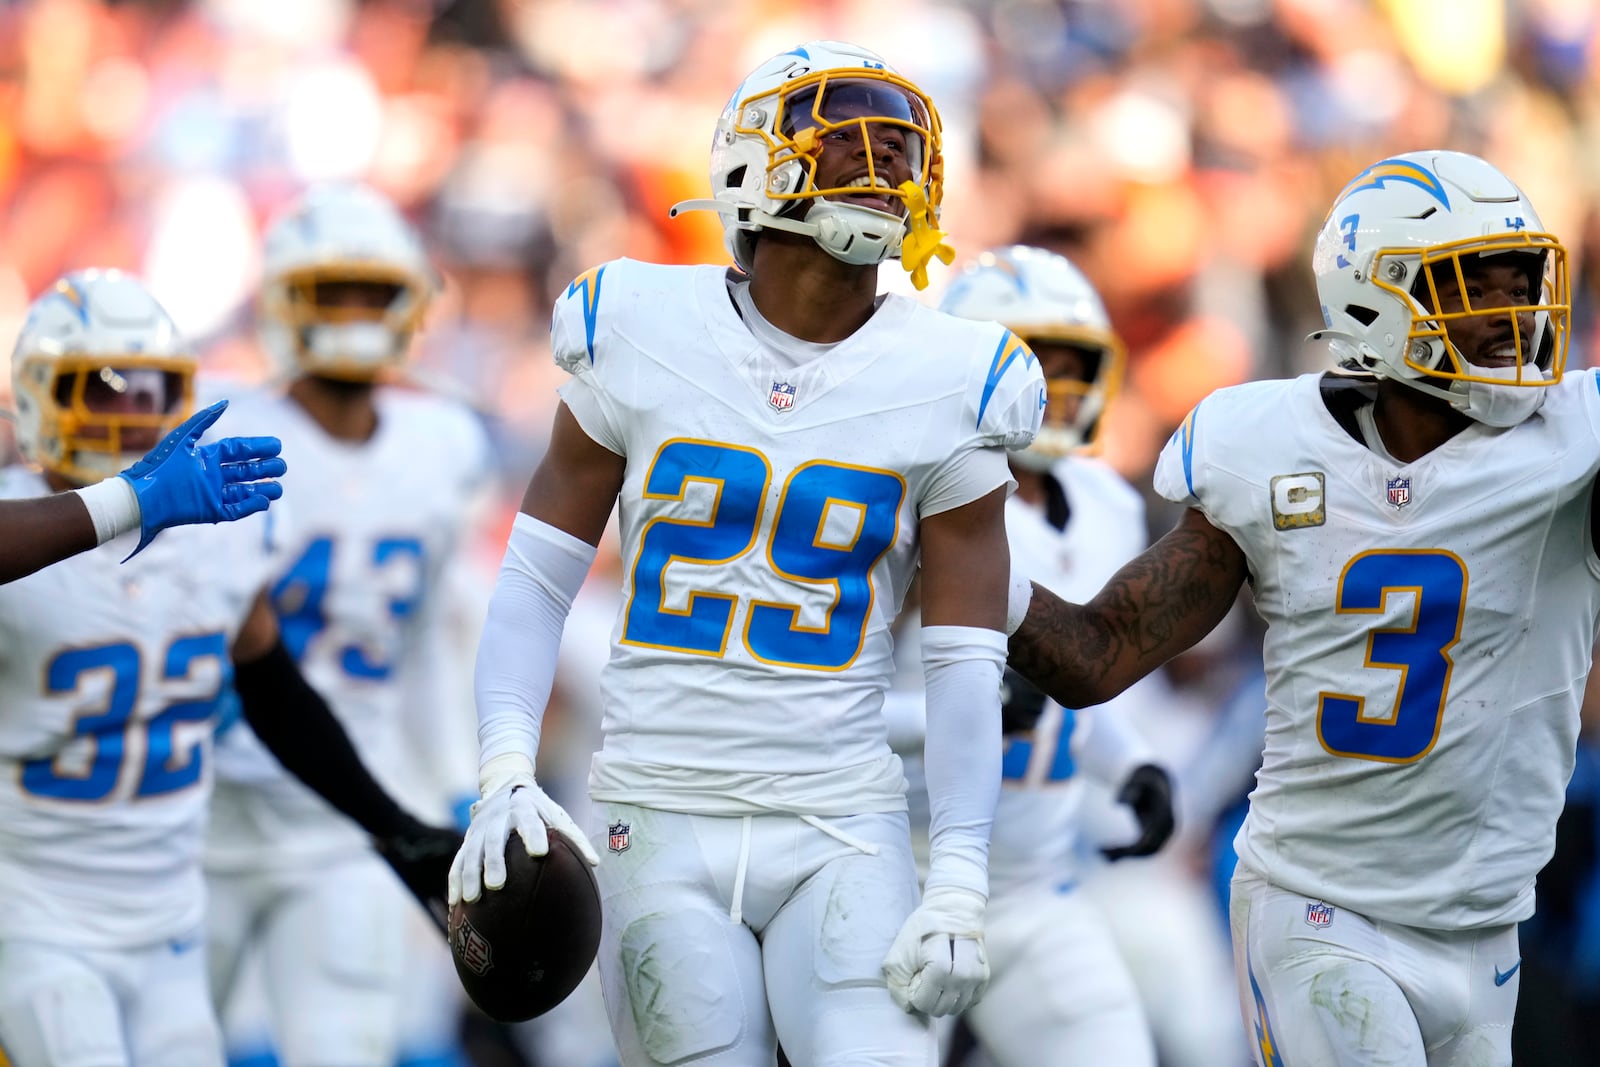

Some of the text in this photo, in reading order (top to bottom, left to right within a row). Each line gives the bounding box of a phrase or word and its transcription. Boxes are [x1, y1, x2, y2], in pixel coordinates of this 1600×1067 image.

[1505, 217, 1525, 232] LA
[771, 391, 792, 408] NFL
[1274, 475, 1321, 516] C
[1388, 488, 1409, 504] NFL
[619, 436, 907, 672] 29
[269, 532, 427, 684] 43
[1316, 548, 1470, 765] 3
[17, 626, 231, 806] 32
[610, 834, 628, 849] NFL
[1309, 910, 1330, 924] NFL
[465, 935, 489, 968] NFL
